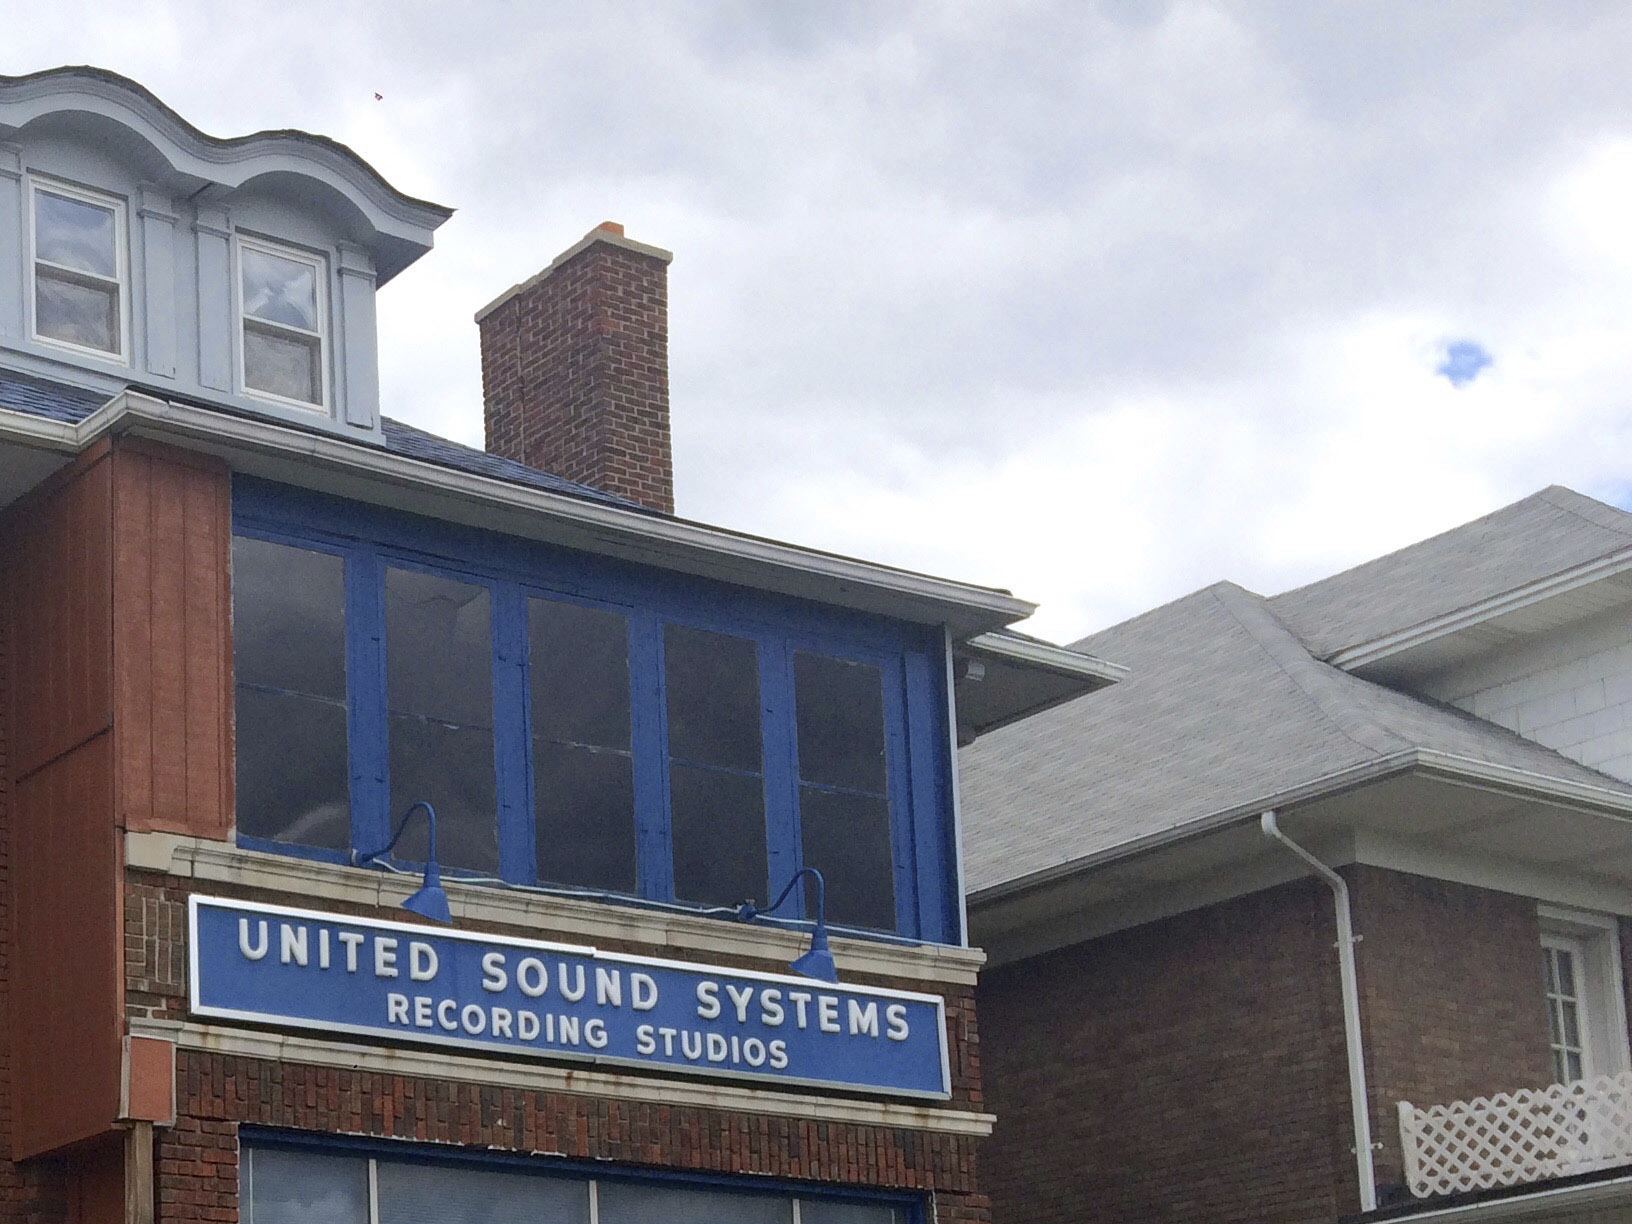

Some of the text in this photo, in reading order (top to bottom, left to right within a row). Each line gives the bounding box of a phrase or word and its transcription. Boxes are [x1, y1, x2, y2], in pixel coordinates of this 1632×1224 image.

[237, 916, 910, 1042] UNITED SOUND SYSTEMS
[386, 992, 789, 1070] RECORDING STUDIOS
